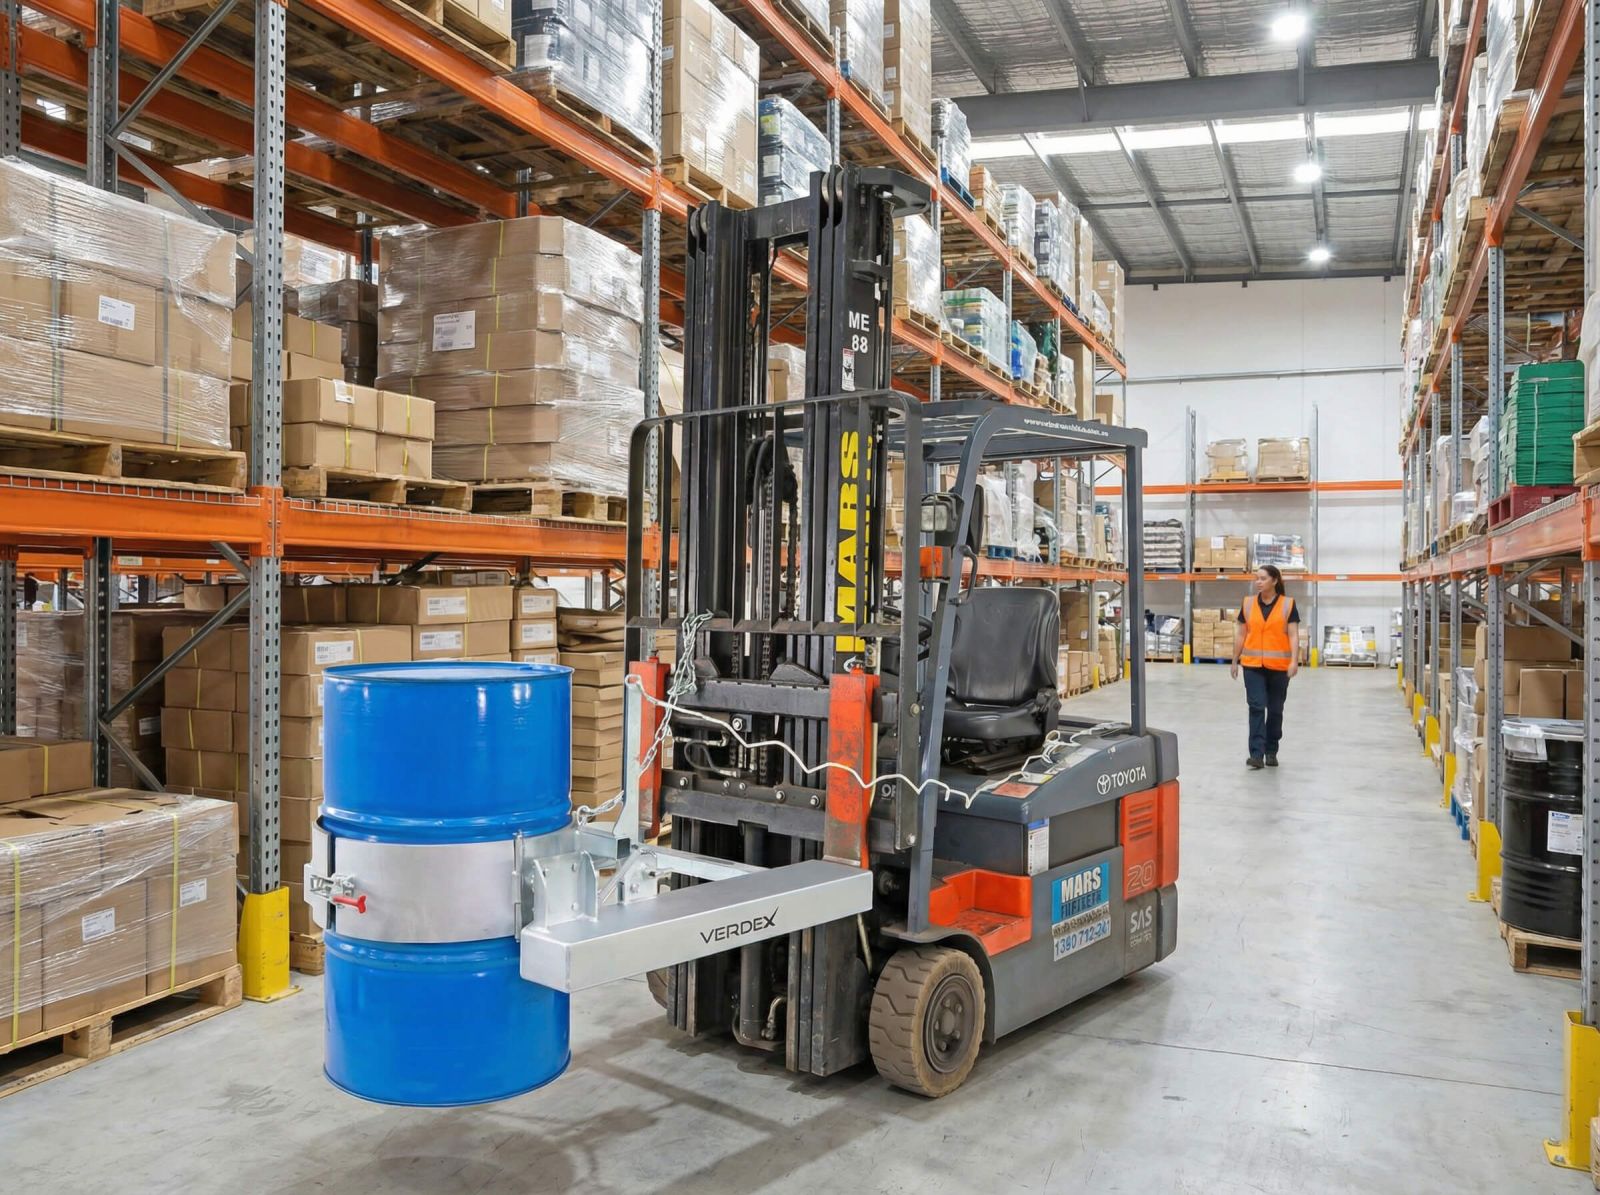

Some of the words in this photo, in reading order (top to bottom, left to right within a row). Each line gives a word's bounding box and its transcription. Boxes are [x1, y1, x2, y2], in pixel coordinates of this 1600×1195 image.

[848, 310, 870, 332] ME
[851, 334, 868, 354] 88
[835, 431, 859, 653] MARS
[1111, 765, 1147, 788] TOYOTA
[1061, 866, 1102, 904] MARS
[1127, 859, 1156, 894] 20
[699, 906, 779, 944] VERDEX
[1130, 905, 1153, 934] SAS
